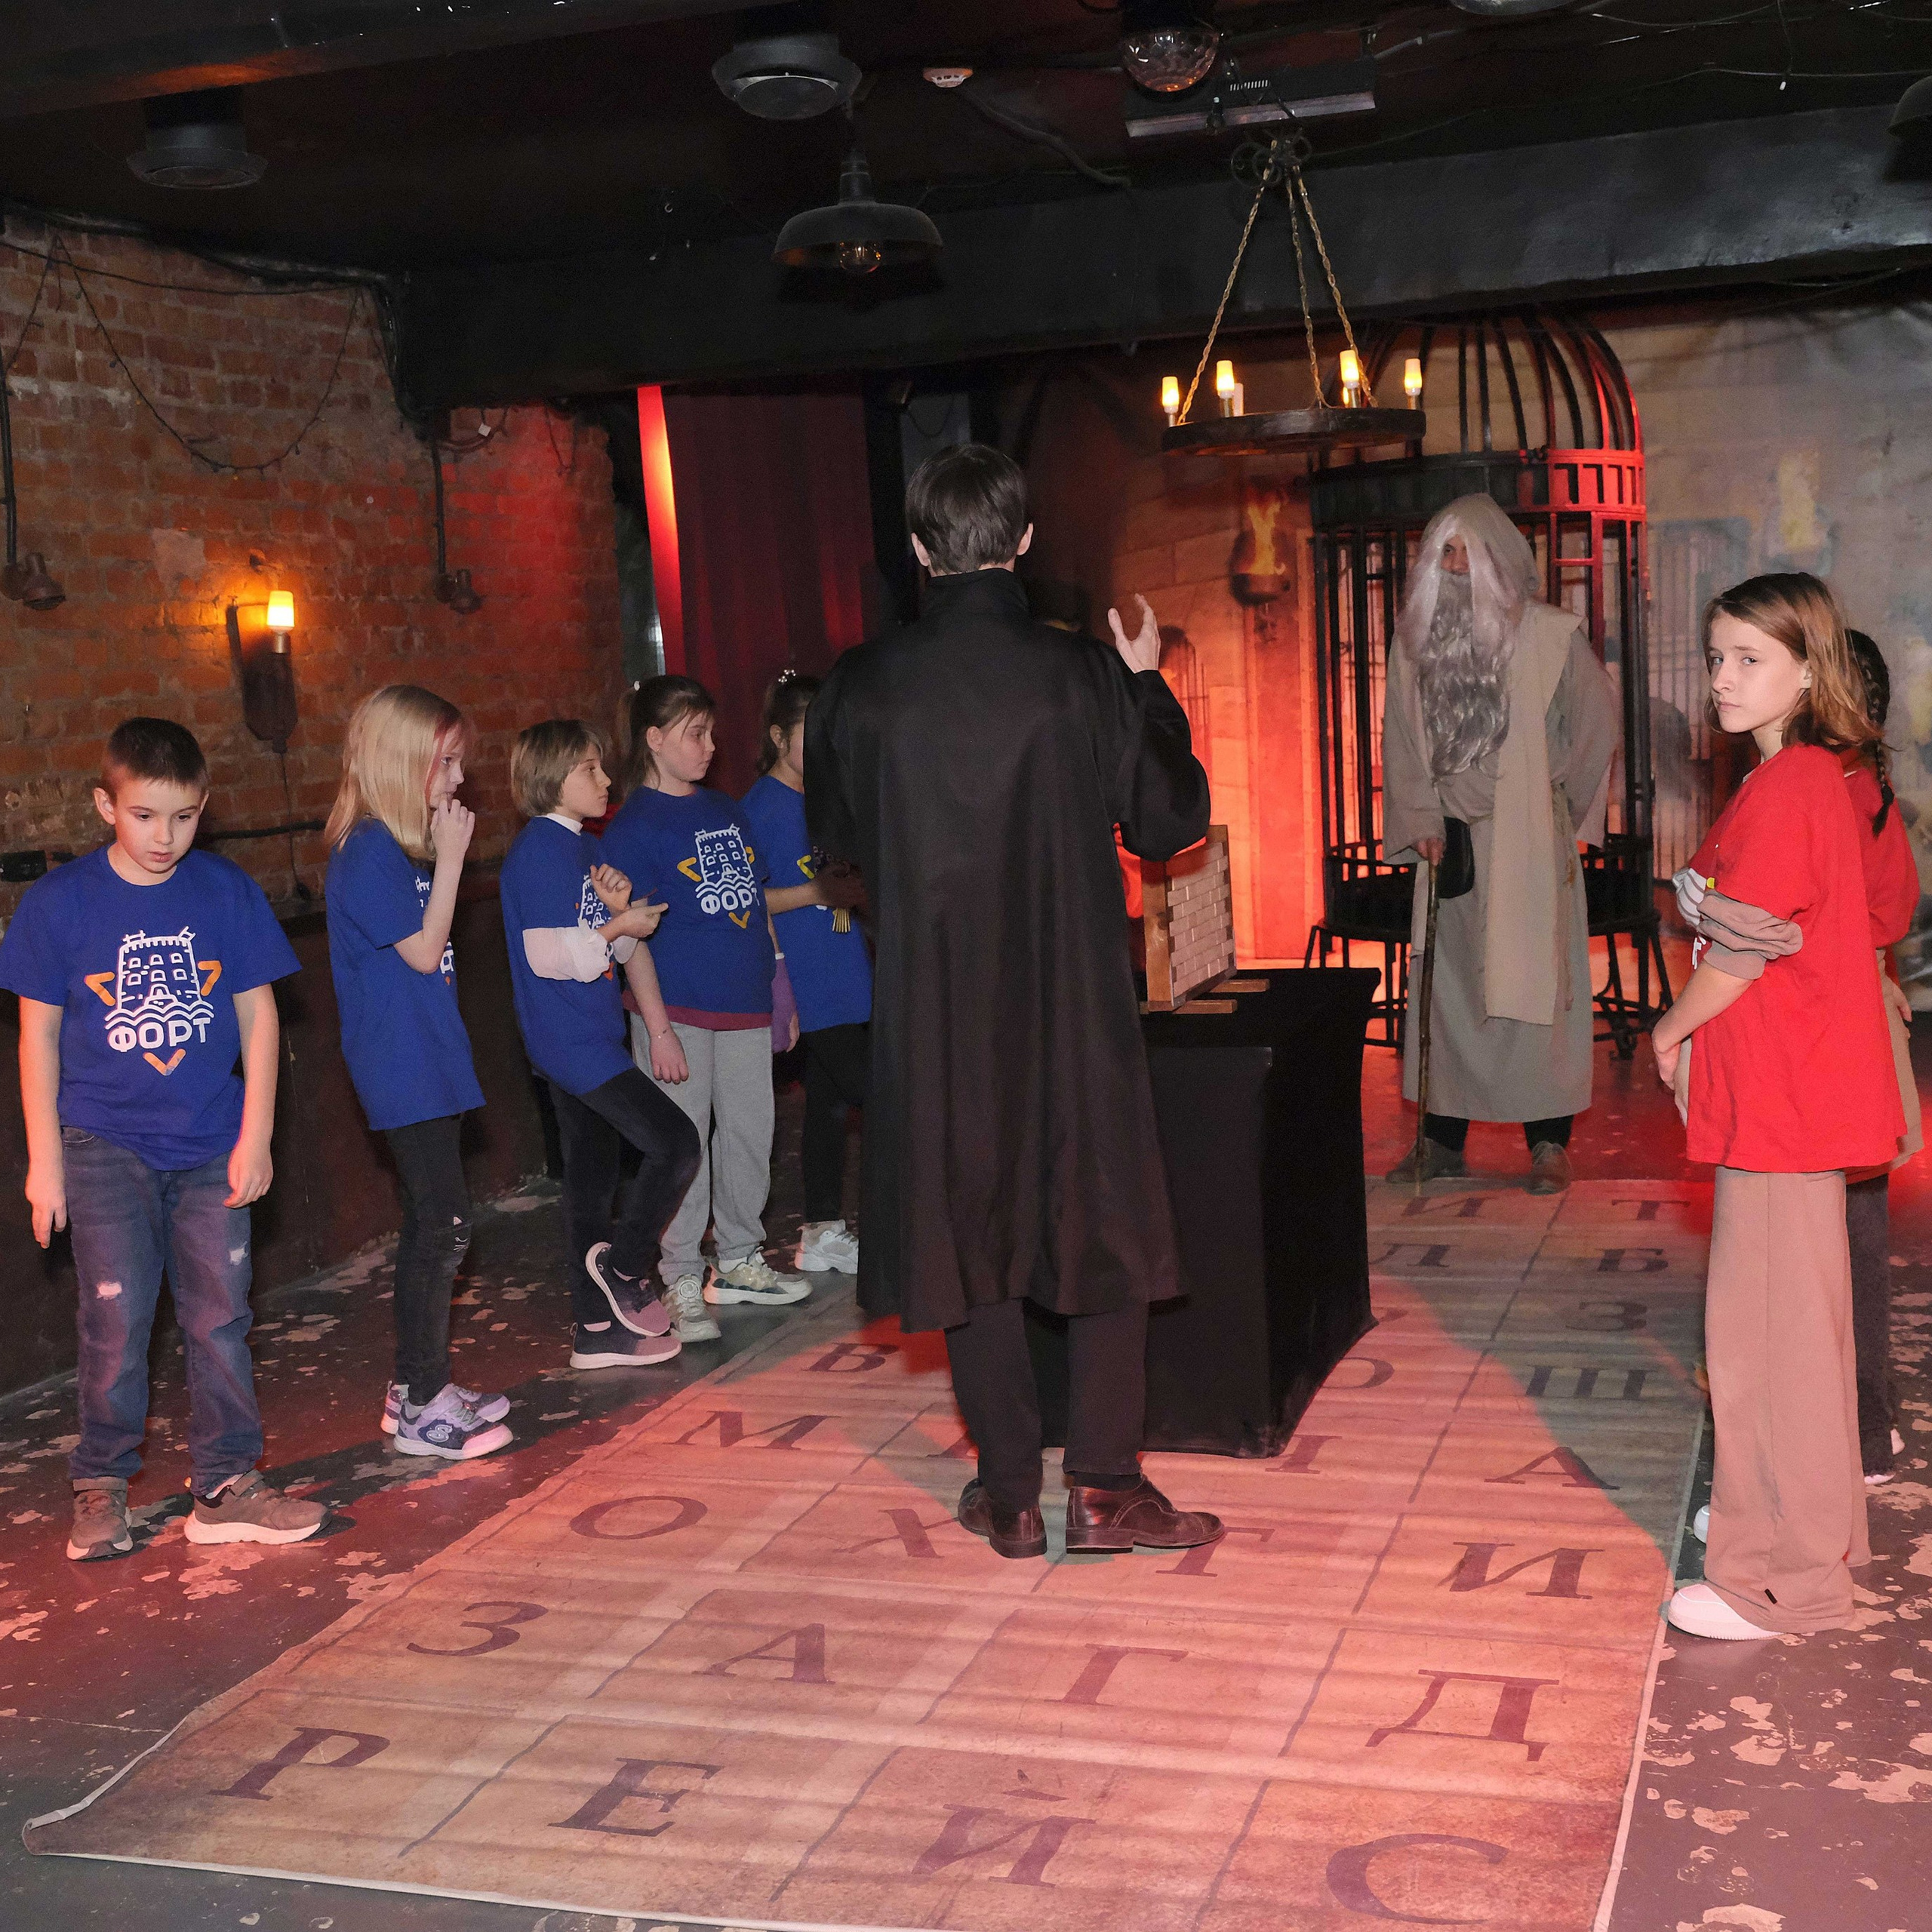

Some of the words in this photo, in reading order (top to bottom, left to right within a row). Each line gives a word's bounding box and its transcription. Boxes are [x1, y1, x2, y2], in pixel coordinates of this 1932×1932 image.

[108, 1017, 211, 1053] ФОРТ
[1611, 1199, 1690, 1221] Т
[801, 1342, 899, 1373] В
[663, 1410, 842, 1451] М
[1484, 1447, 1620, 1491] А
[570, 1495, 708, 1540] О
[1449, 1541, 1604, 1600] И
[692, 1623, 835, 1684] А
[1044, 1643, 1189, 1706] Г
[1364, 1669, 1560, 1762] Д
[209, 1727, 391, 1801] Р
[548, 1757, 724, 1837] Е
[911, 1788, 1097, 1887] Й
[1325, 1833, 1510, 1925] С
